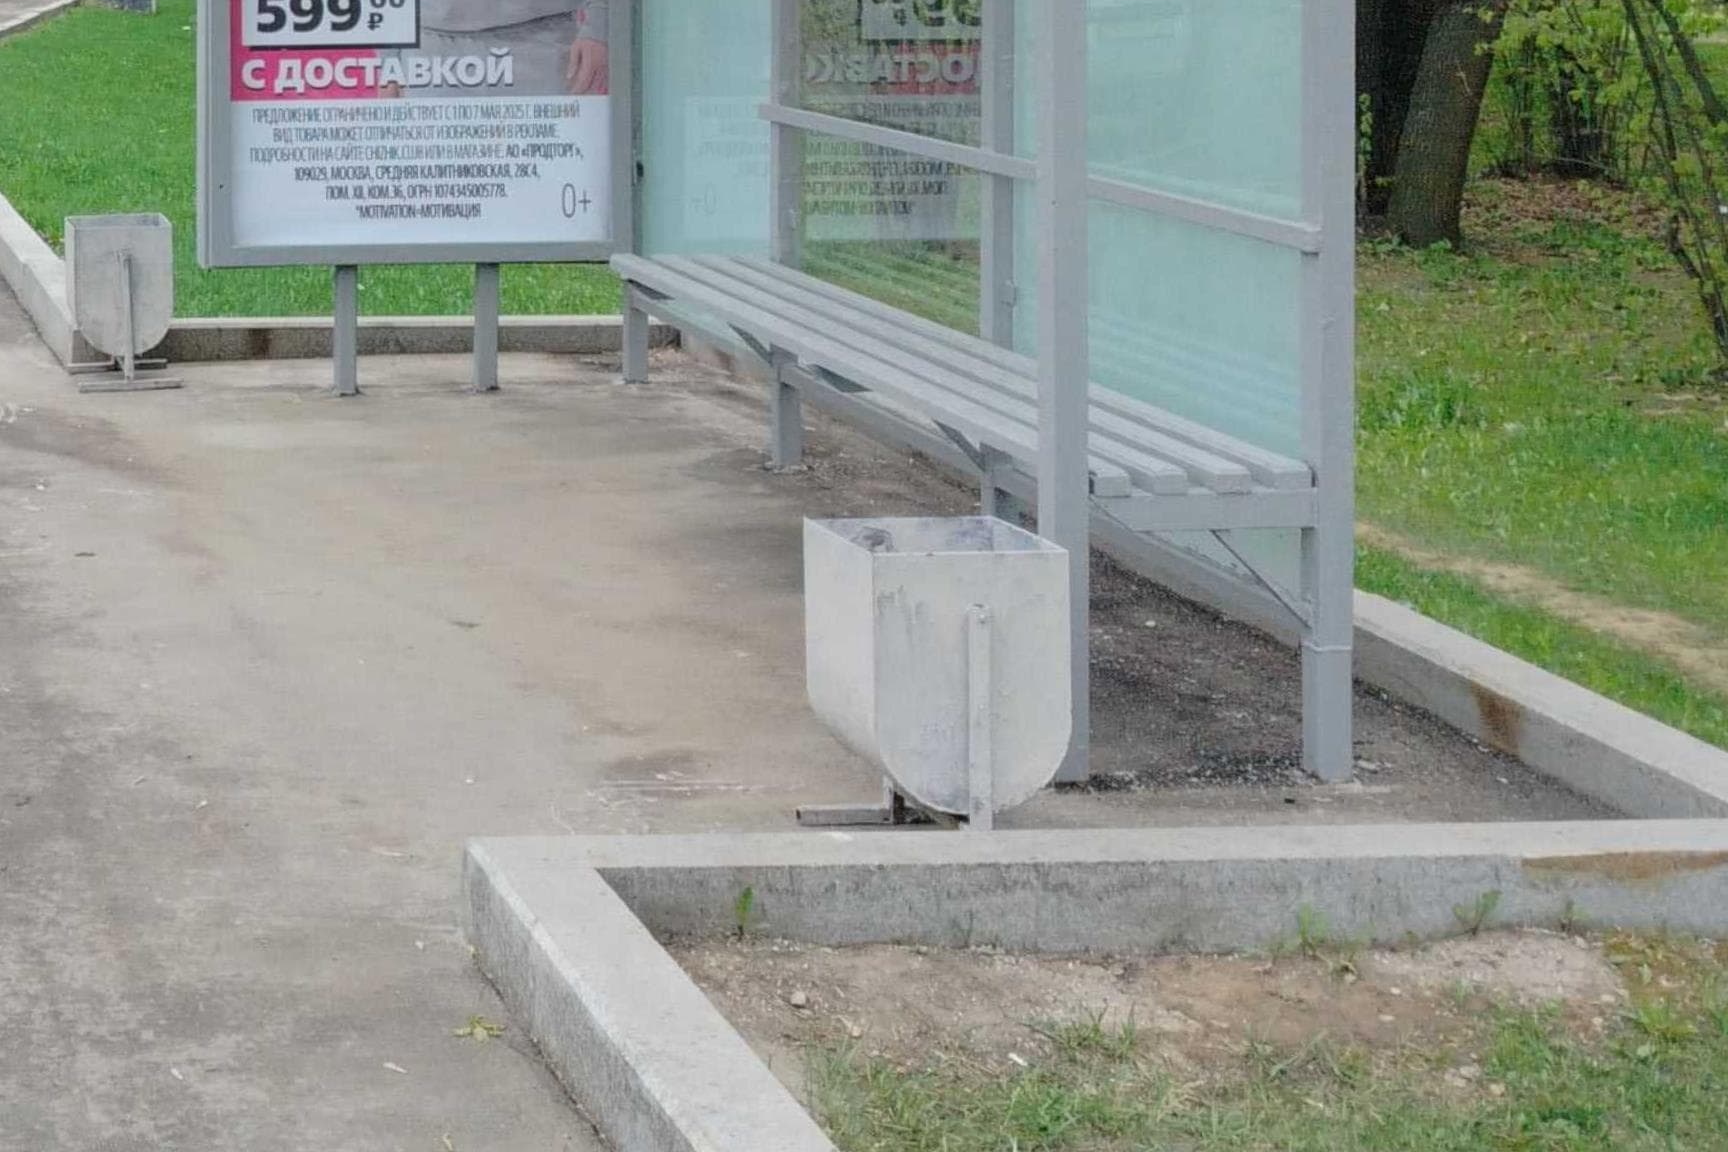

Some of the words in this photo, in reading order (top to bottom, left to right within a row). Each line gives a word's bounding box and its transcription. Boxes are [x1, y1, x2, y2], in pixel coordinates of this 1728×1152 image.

[241, 59, 266, 89] С
[274, 48, 514, 95] ДОСТАВКОЙ
[562, 183, 592, 218] 0+
